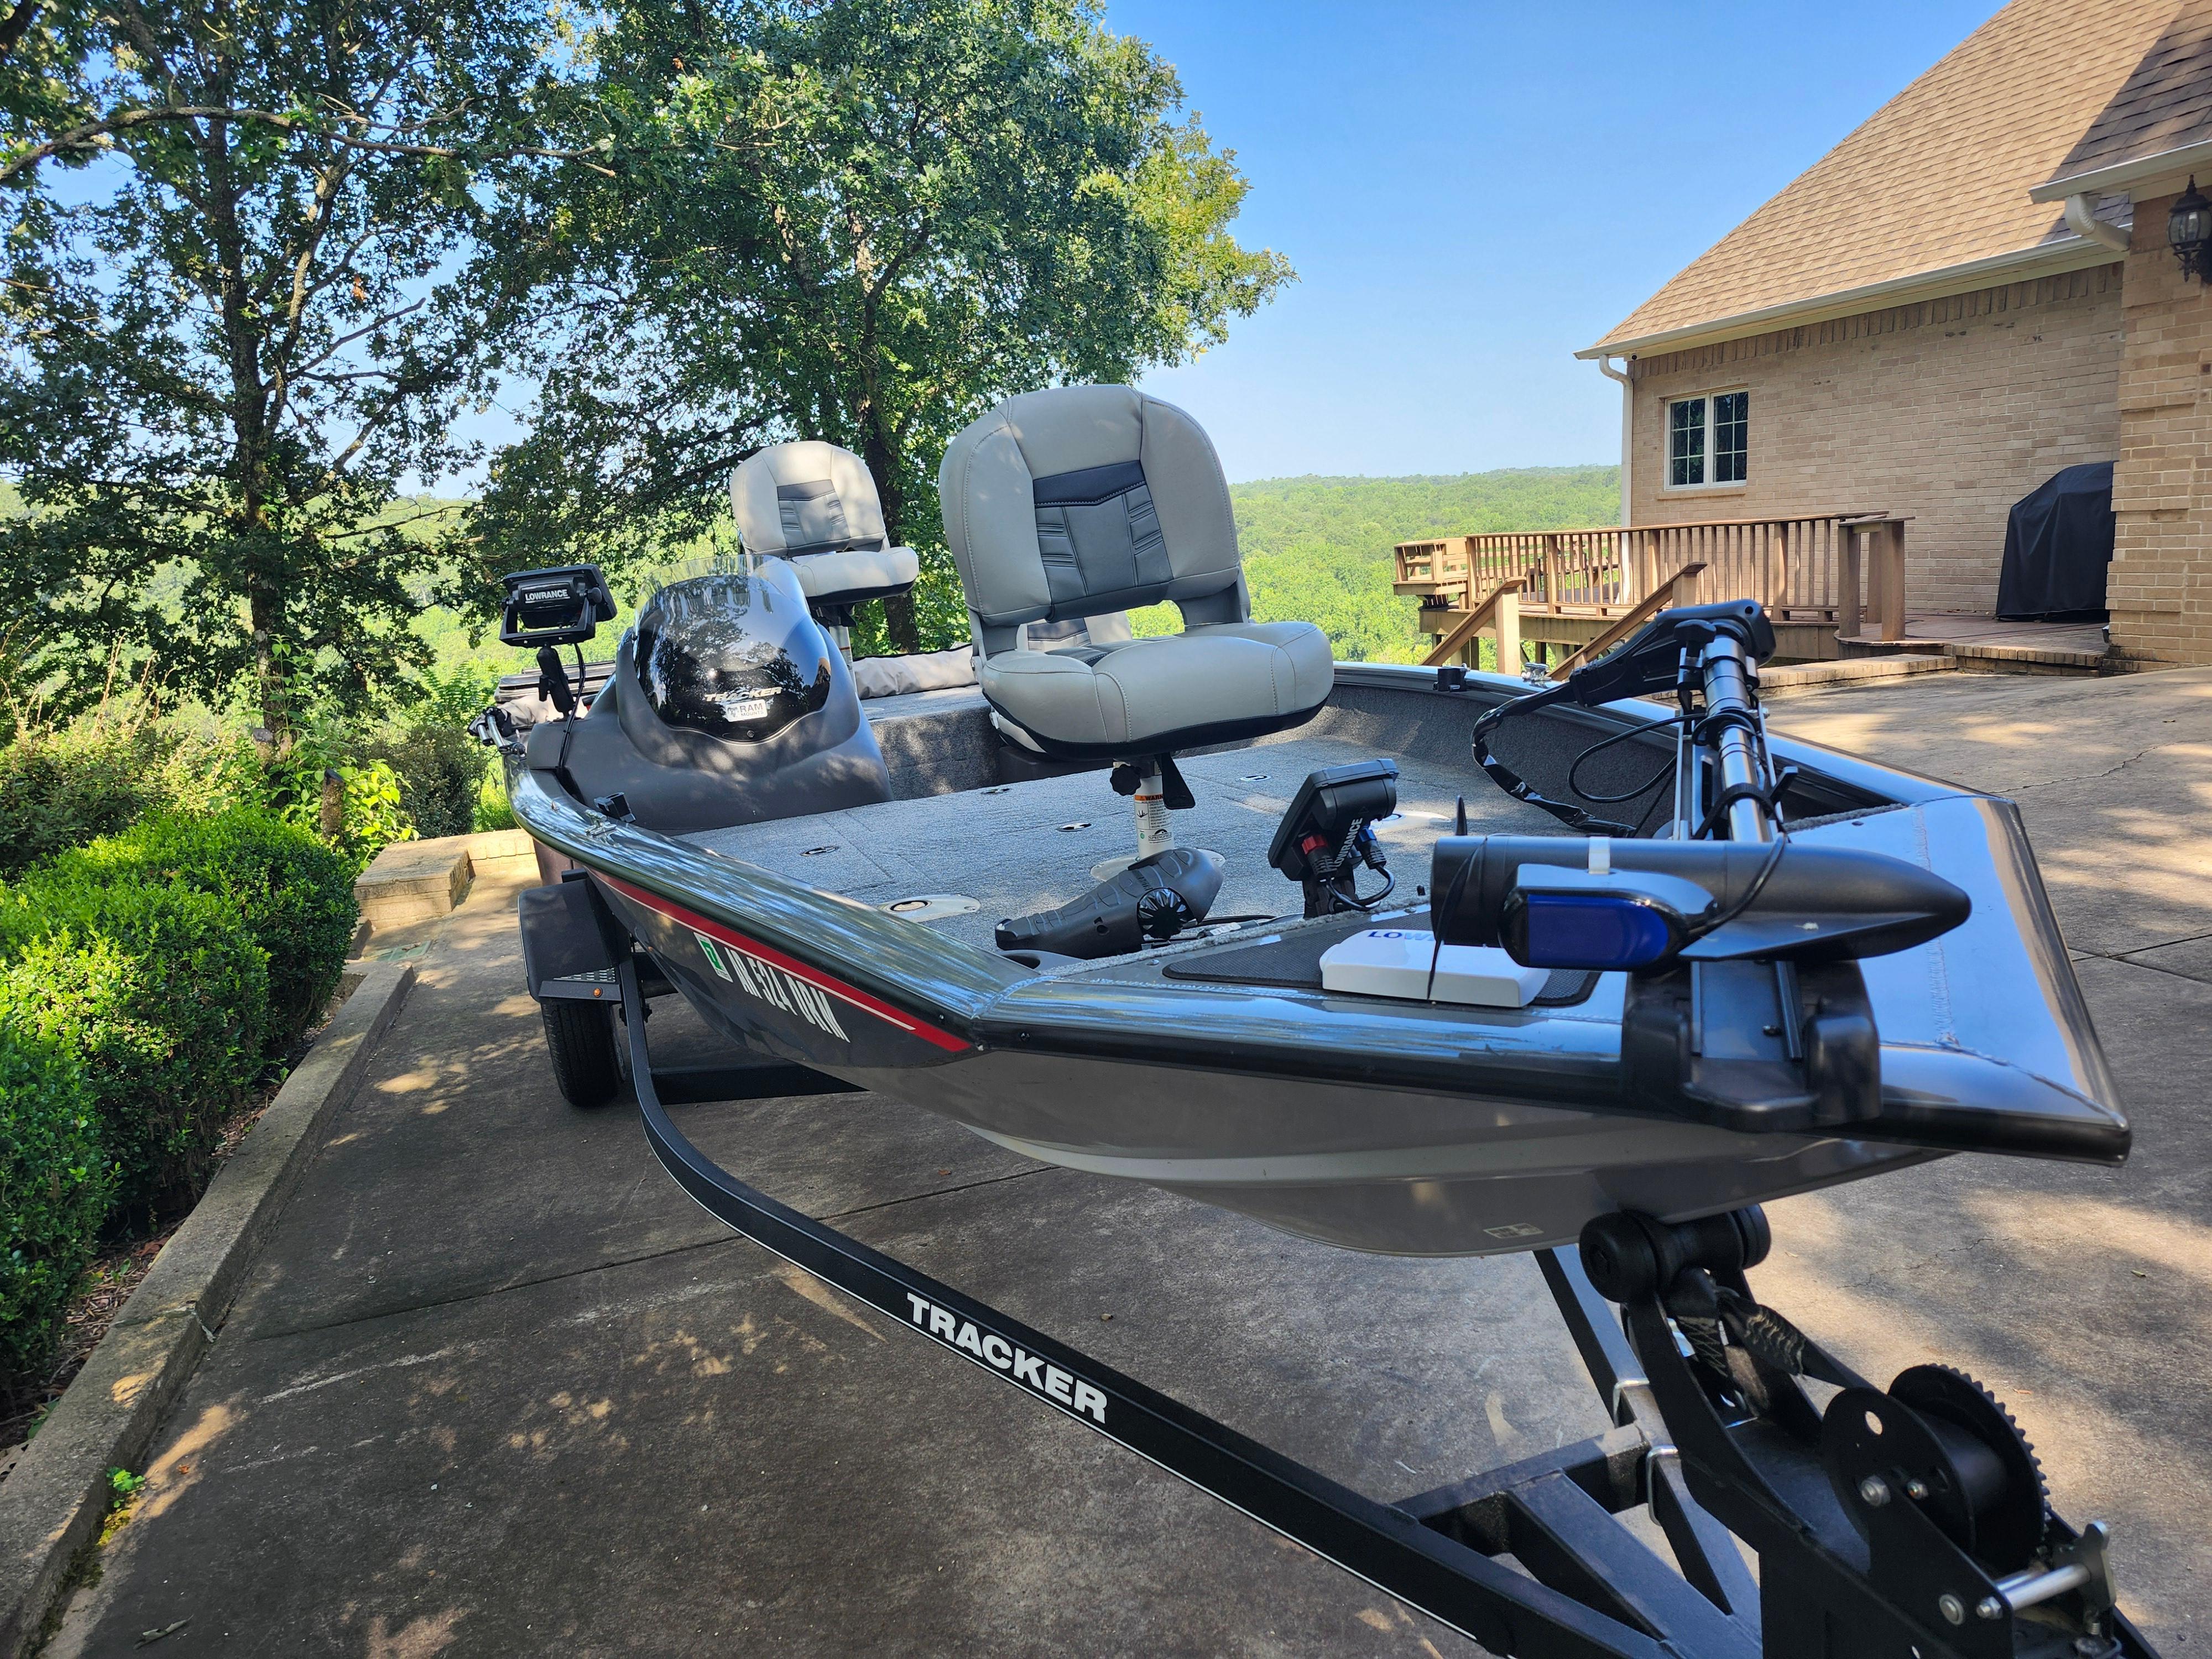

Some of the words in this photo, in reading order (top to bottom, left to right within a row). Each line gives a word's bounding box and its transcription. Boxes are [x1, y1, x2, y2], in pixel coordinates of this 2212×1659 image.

[525, 589, 568, 602] LOWRANCE
[705, 687, 782, 702] TRACKER
[739, 703, 763, 713] RAM
[1332, 817, 1363, 868] LOWRANCE
[724, 947, 763, 999] AR
[747, 957, 798, 1016] 524
[906, 1292, 1109, 1425] TRACKER
